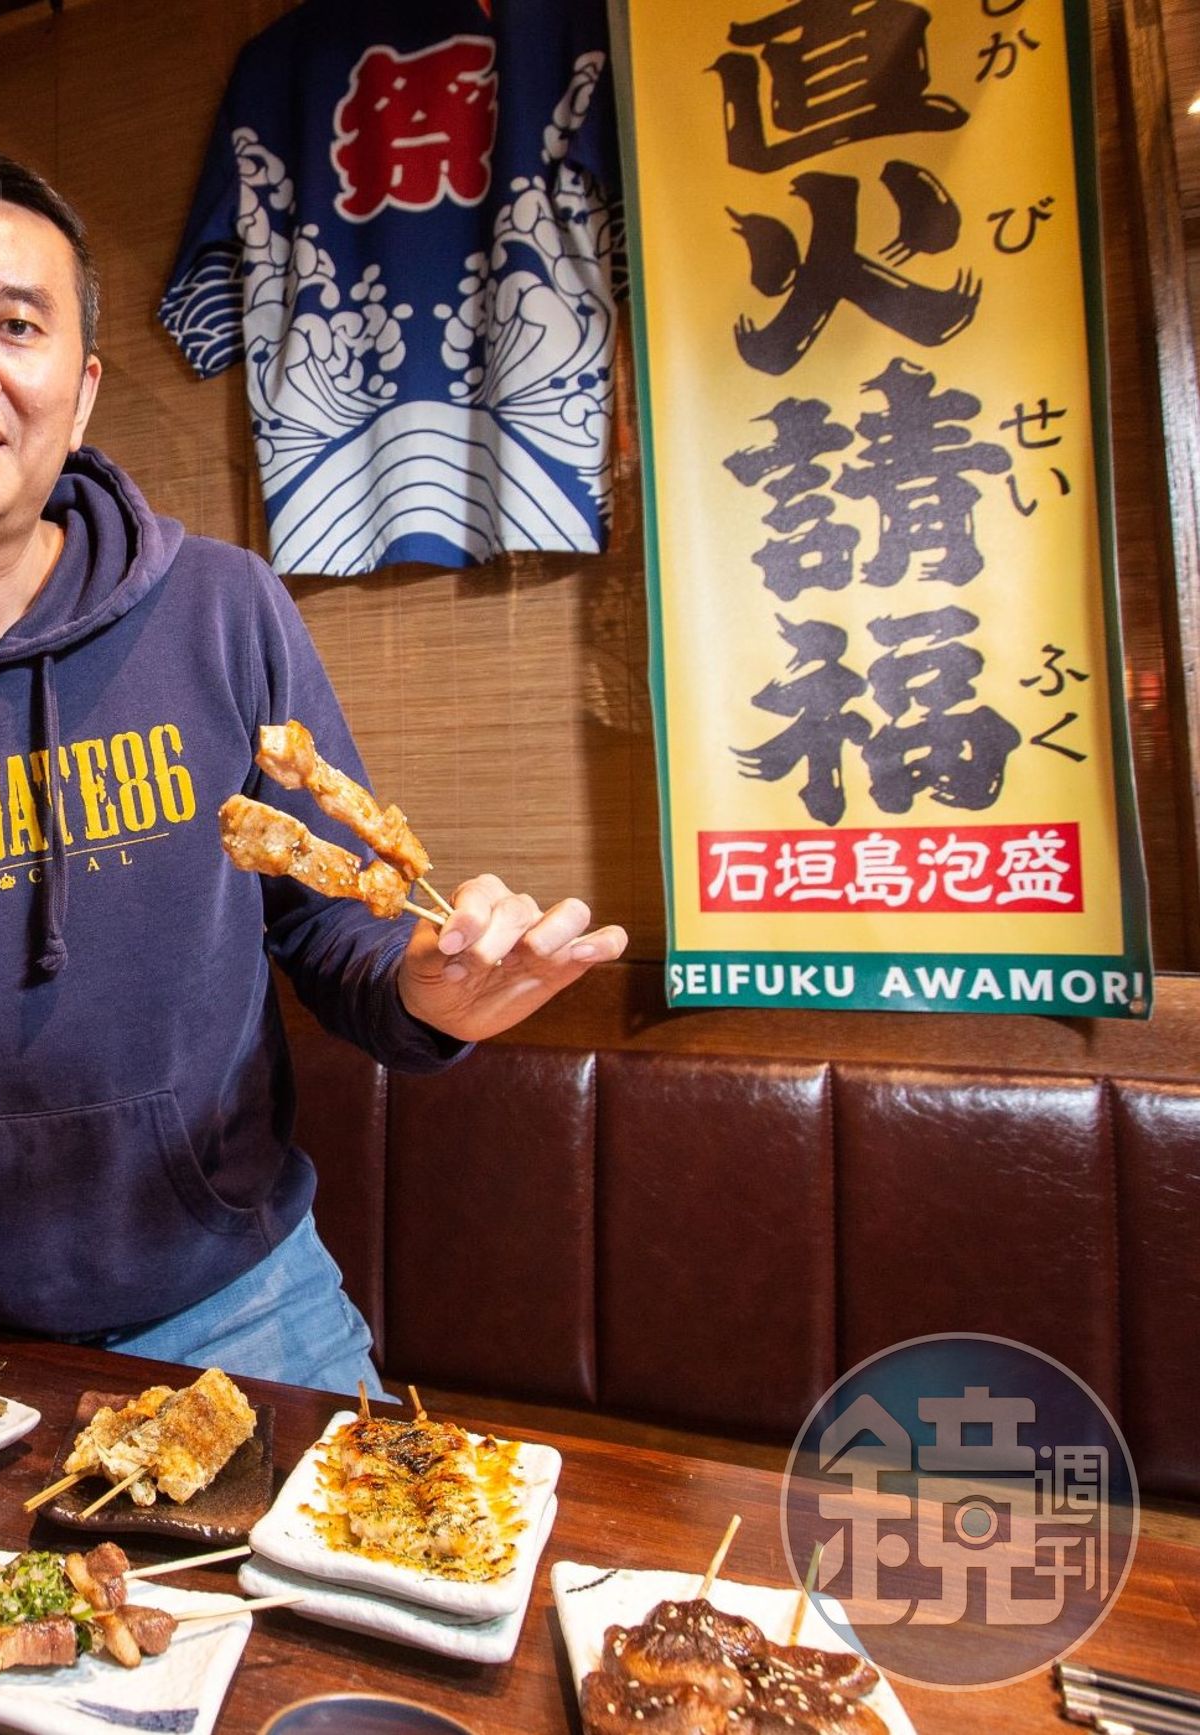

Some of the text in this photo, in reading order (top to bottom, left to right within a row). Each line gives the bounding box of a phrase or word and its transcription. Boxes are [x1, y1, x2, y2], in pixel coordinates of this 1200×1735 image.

[329, 34, 499, 225] 祭
[707, 828, 1077, 908] 石垣島泡盛
[670, 962, 1144, 1005] SEIFUKU AWAMORI
